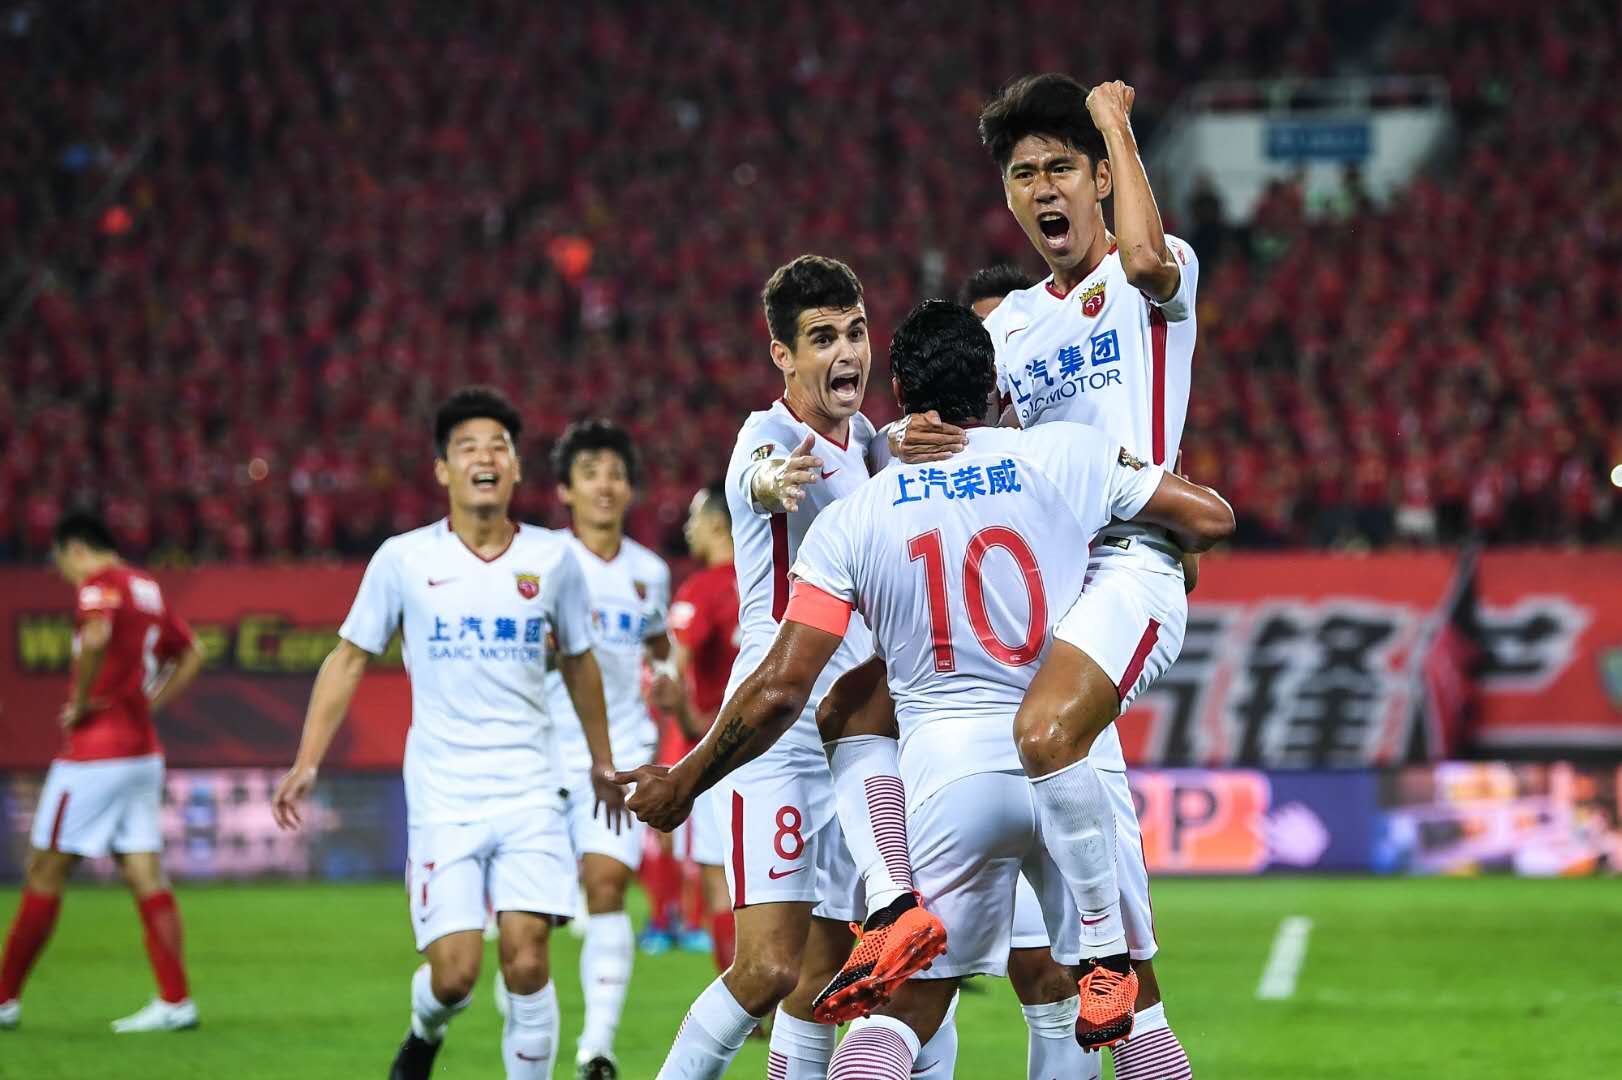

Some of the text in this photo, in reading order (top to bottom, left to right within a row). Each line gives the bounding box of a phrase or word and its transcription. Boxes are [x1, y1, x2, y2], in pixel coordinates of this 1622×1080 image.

[1008, 328, 1121, 404] 上汽集团
[1046, 368, 1122, 404] MOTOR
[892, 458, 1022, 506] 上汽荣威
[906, 525, 1049, 673] 10
[427, 615, 544, 643] 上汽集团
[428, 646, 472, 659] SAIC
[773, 805, 804, 861] 8
